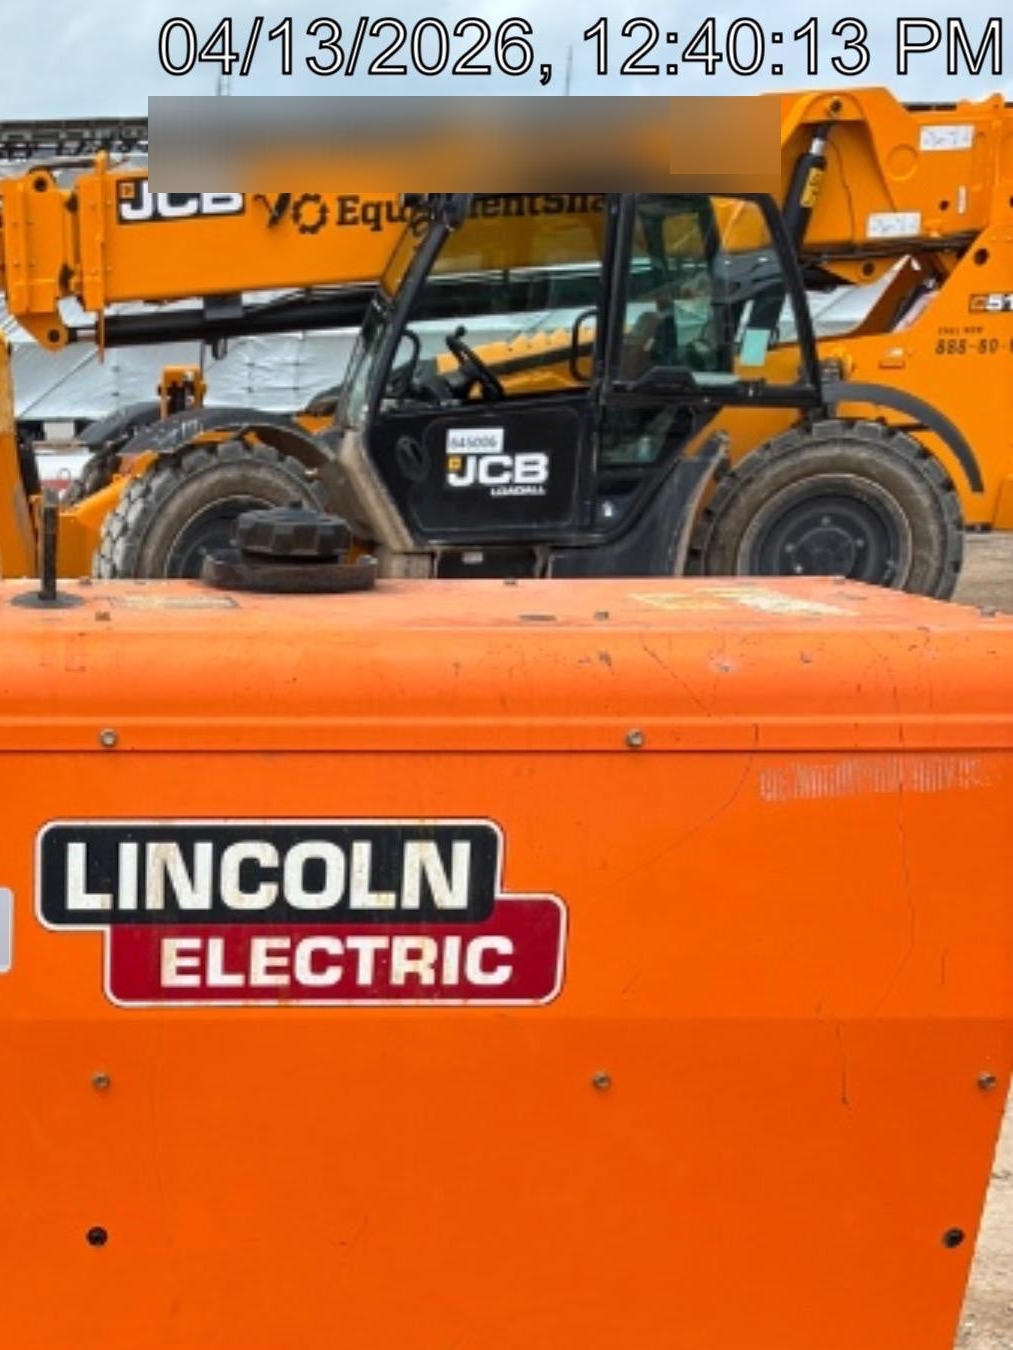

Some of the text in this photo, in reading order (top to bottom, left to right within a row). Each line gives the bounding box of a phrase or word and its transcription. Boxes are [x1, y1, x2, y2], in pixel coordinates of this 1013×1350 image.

[447, 452, 549, 487] JCB
[66, 840, 471, 911] LINCOLN
[160, 935, 514, 989] ELECTRIC
